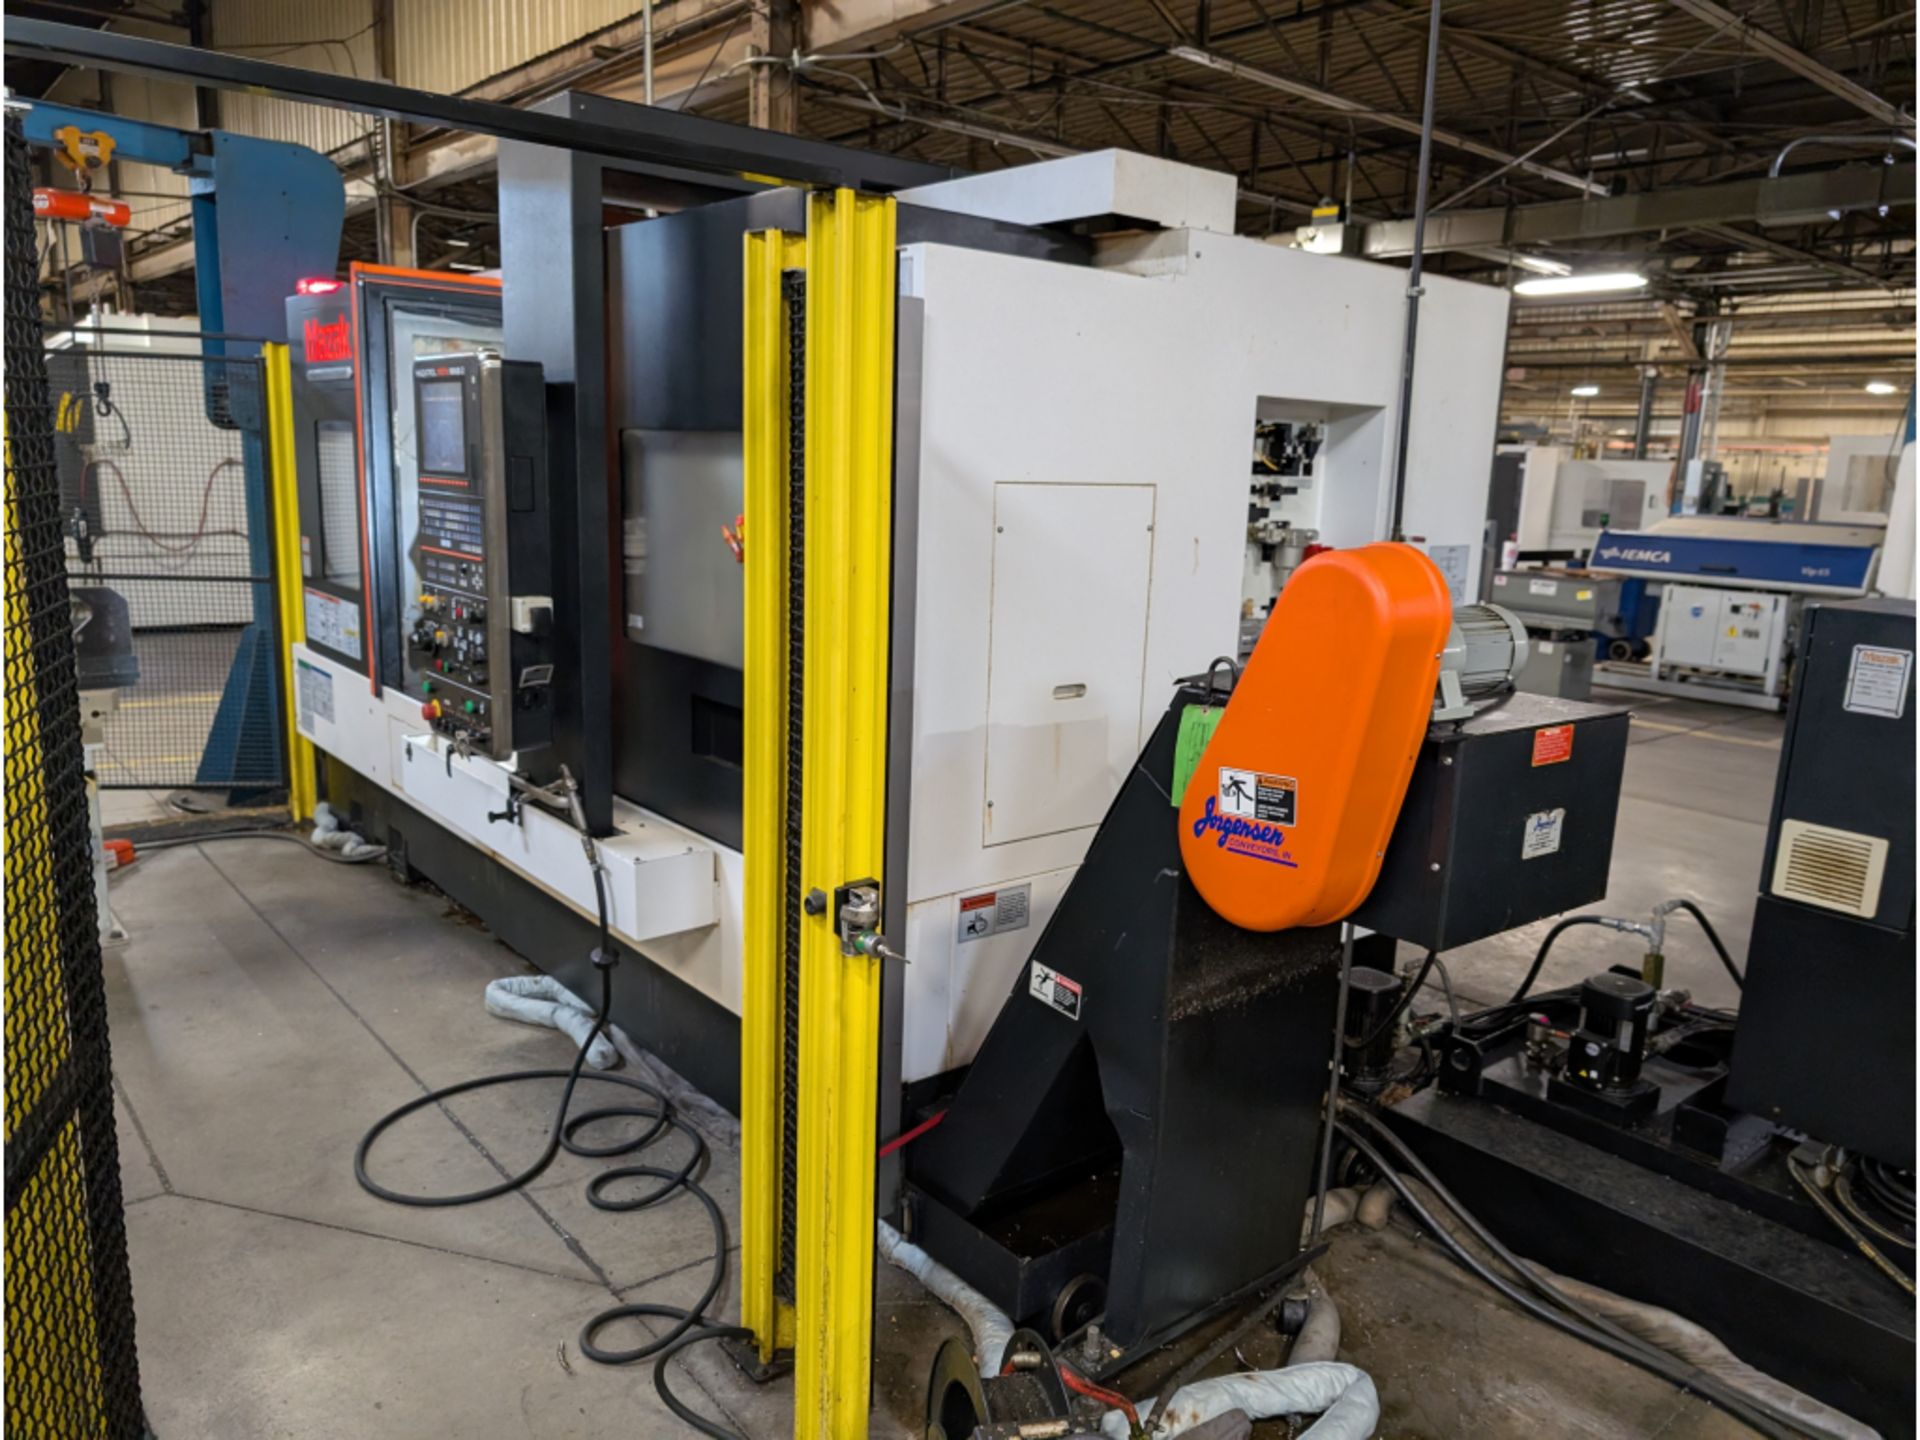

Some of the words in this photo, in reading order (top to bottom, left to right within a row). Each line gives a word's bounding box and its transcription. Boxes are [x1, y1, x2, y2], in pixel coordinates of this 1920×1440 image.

[303, 313, 353, 362] Mazak
[1621, 549, 1671, 563] IEMCA
[1193, 795, 1284, 848] Jorgensen
